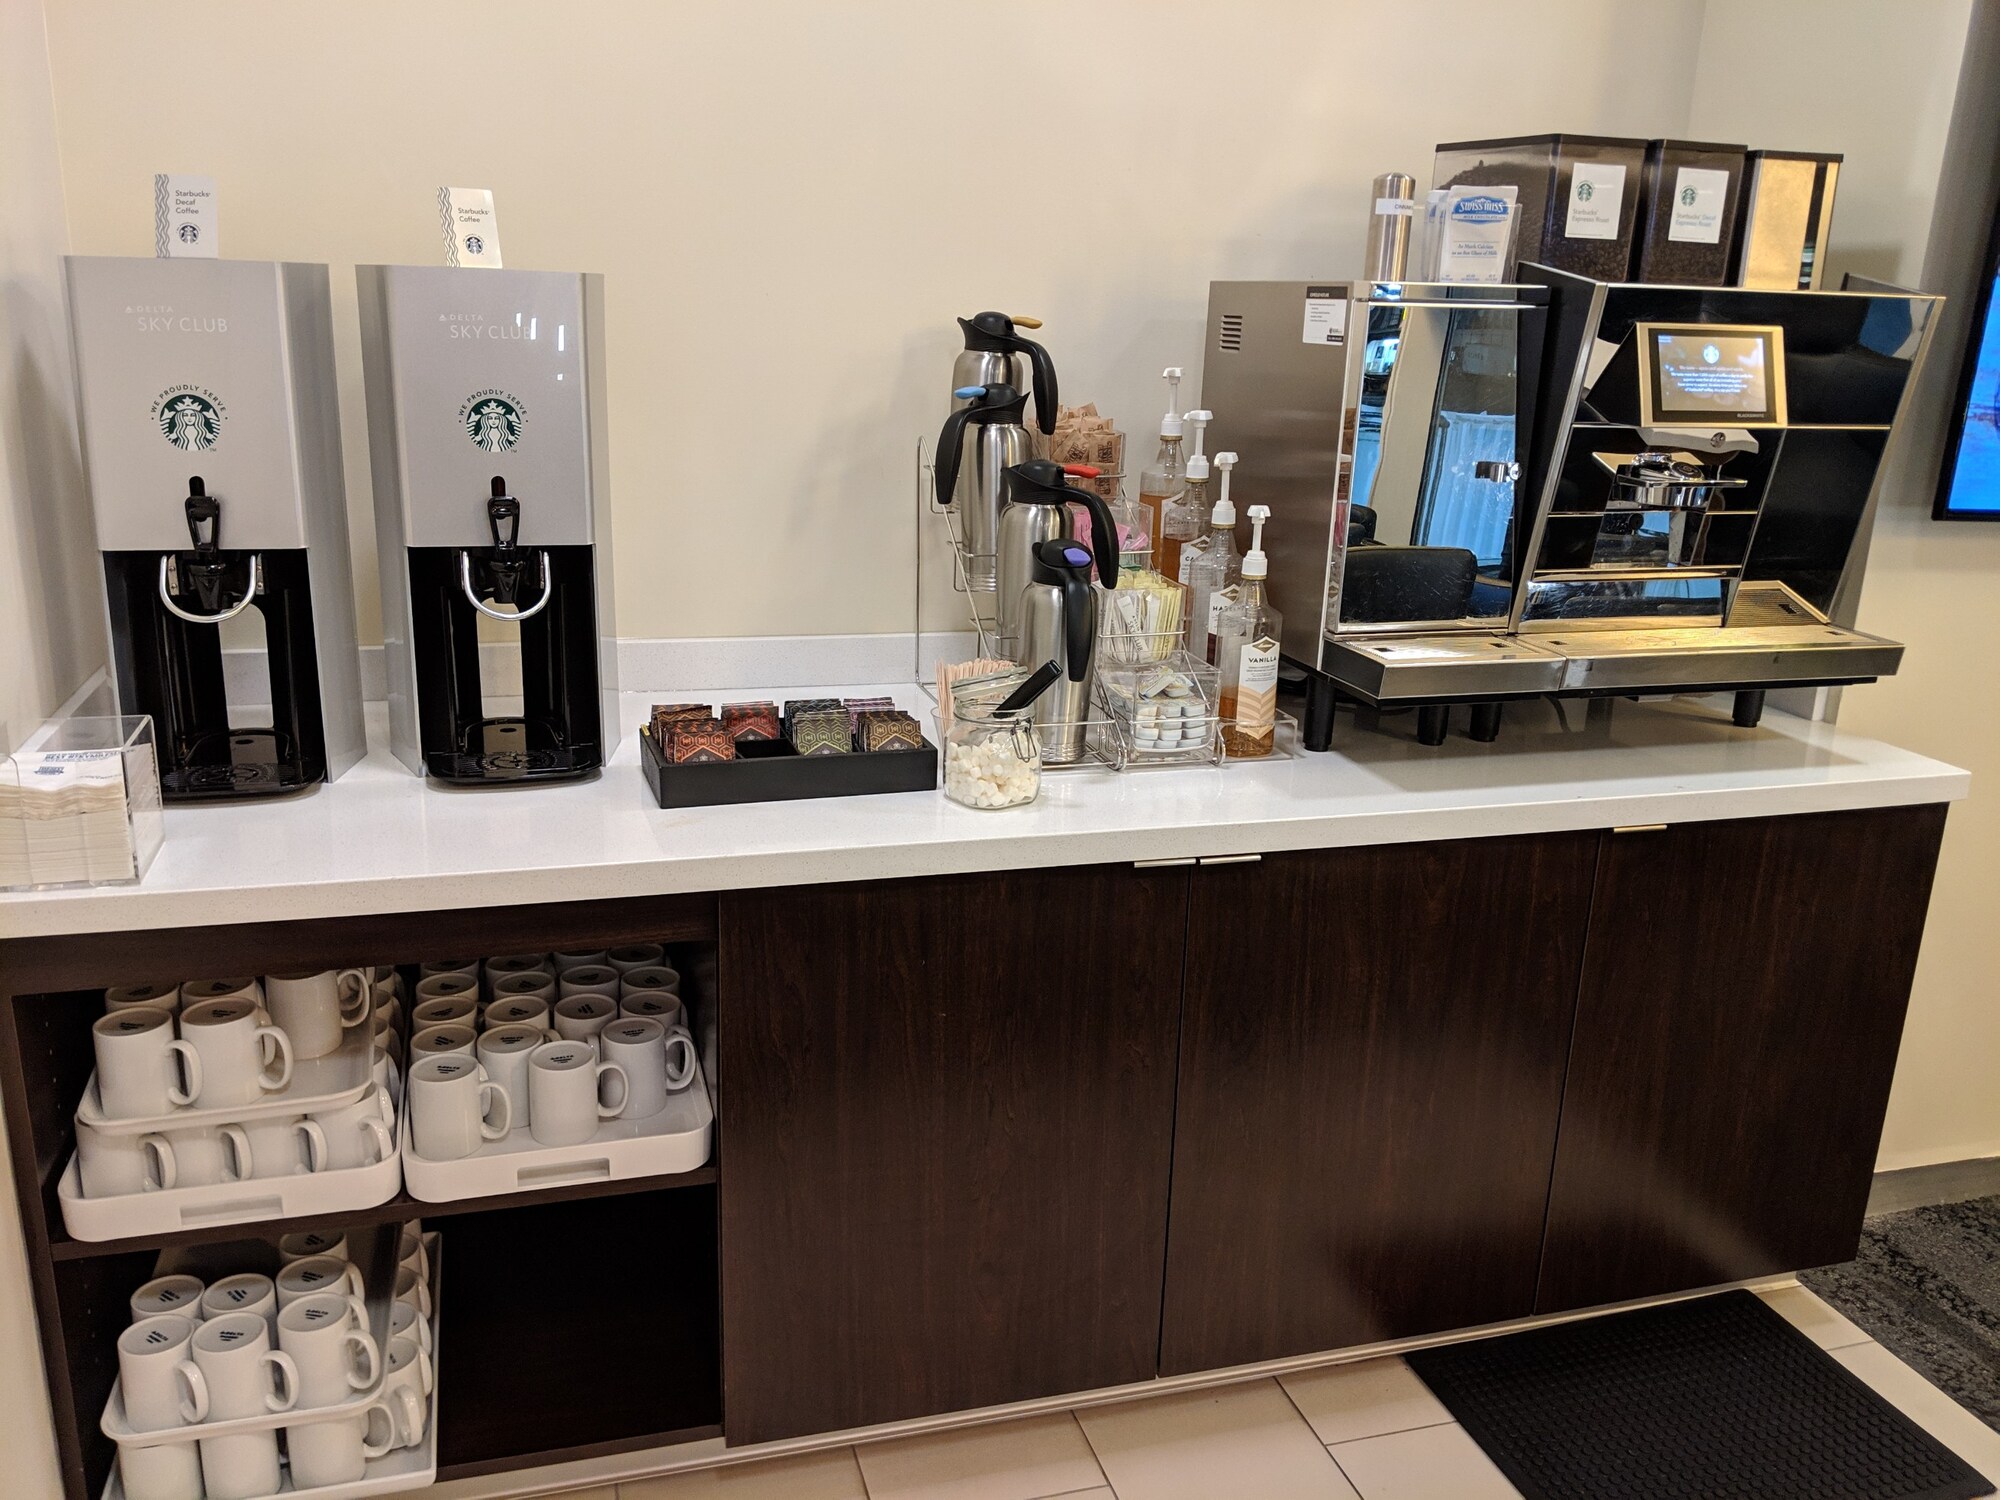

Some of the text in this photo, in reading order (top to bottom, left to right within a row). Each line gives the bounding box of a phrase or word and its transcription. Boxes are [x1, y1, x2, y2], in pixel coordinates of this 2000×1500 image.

[175, 207, 200, 215] Coffee
[457, 207, 490, 215] Starbucks
[136, 305, 174, 313] DELTA
[138, 317, 228, 333] SKY CLUB
[449, 325, 533, 340] SKY CLUB
[150, 384, 227, 414] WE PROUDLY SERVE
[458, 388, 528, 416] WE PROUDLY SERVE
[1248, 655, 1277, 664] VANILLA
